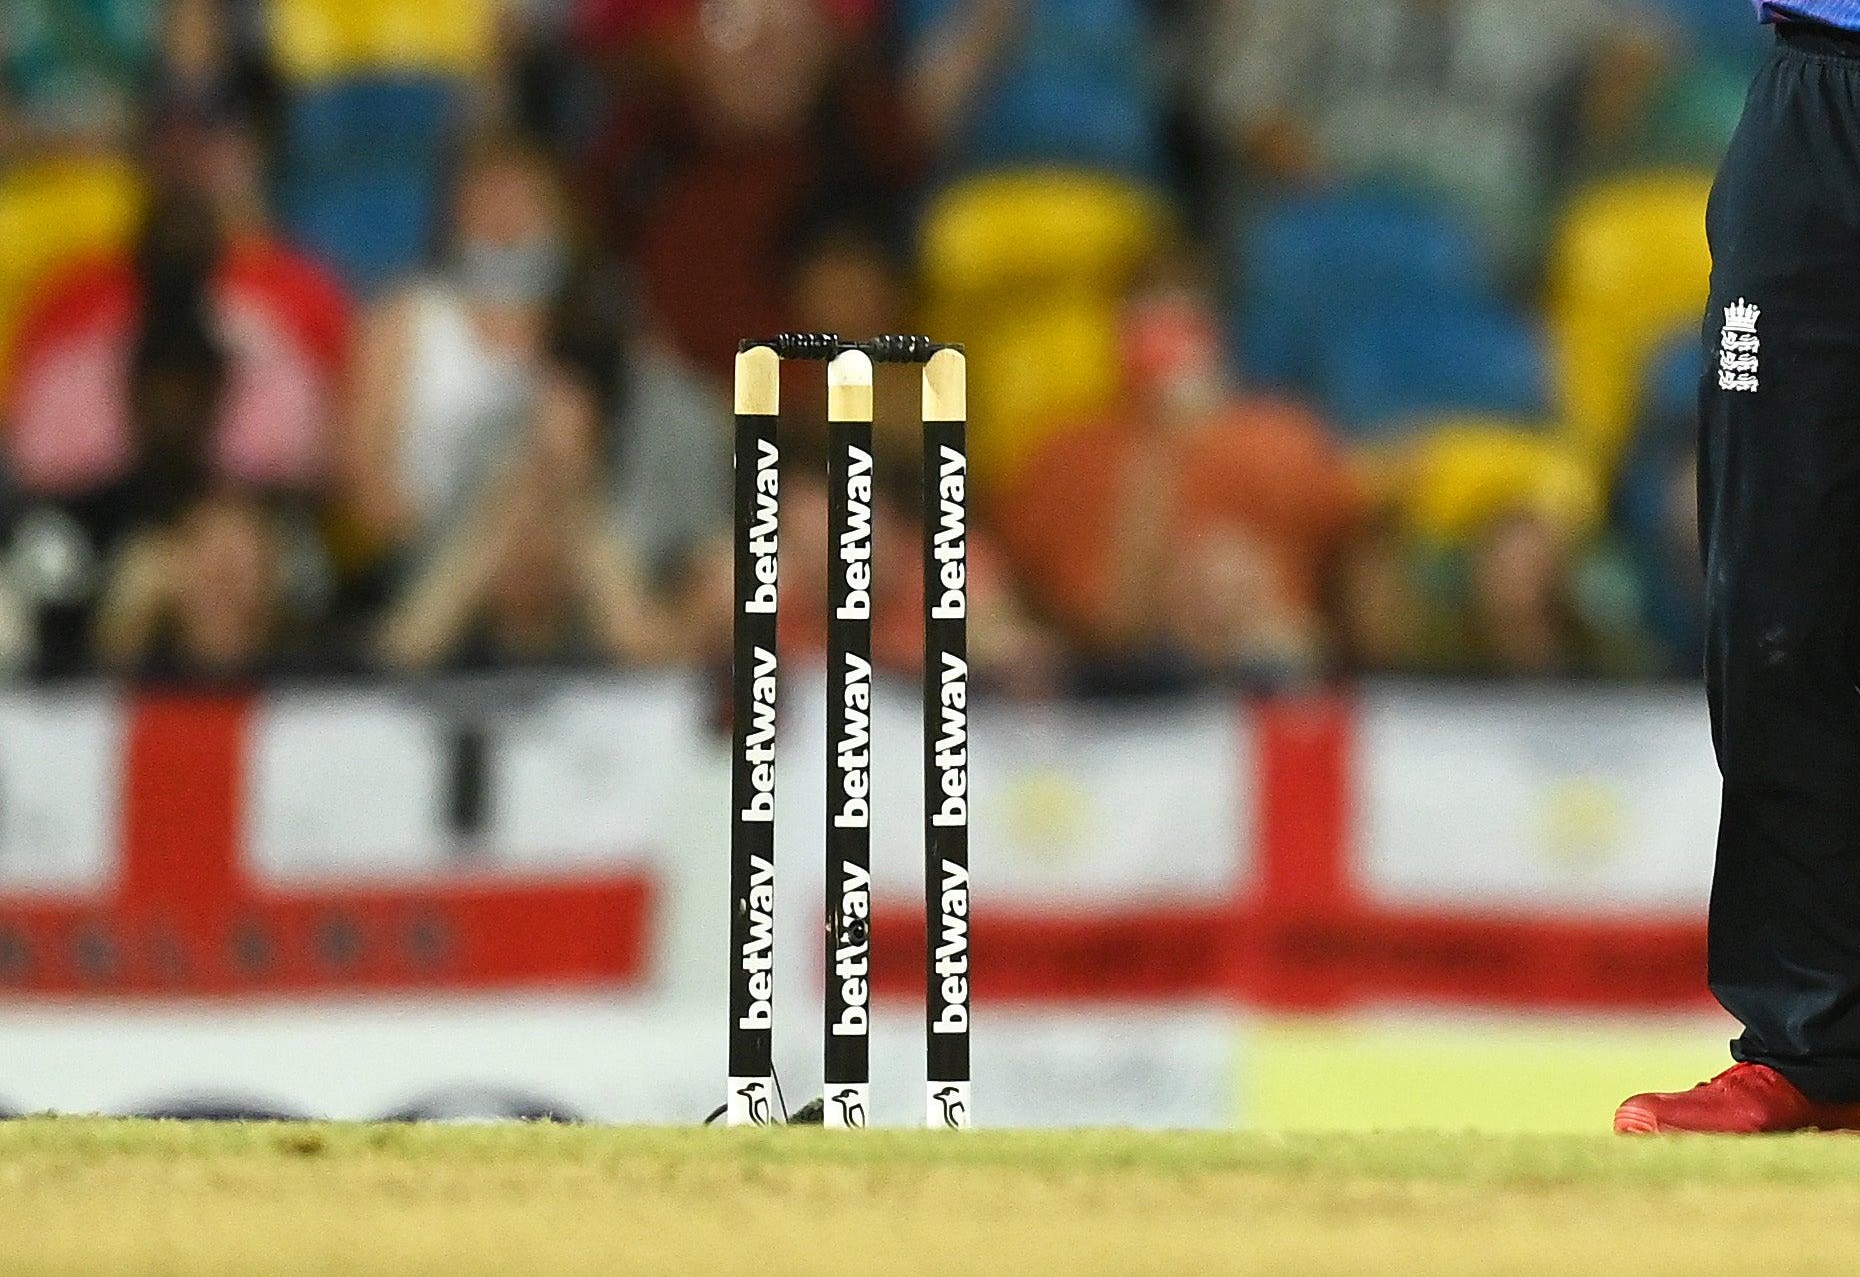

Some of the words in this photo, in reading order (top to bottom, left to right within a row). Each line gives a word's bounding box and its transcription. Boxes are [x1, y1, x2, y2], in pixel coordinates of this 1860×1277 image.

[836, 444, 873, 620] betway
[932, 444, 967, 620] betway
[741, 646, 777, 822] betway
[834, 651, 872, 828] betway
[932, 651, 968, 827] betway
[739, 854, 774, 1030] betway
[933, 858, 969, 1034] betway
